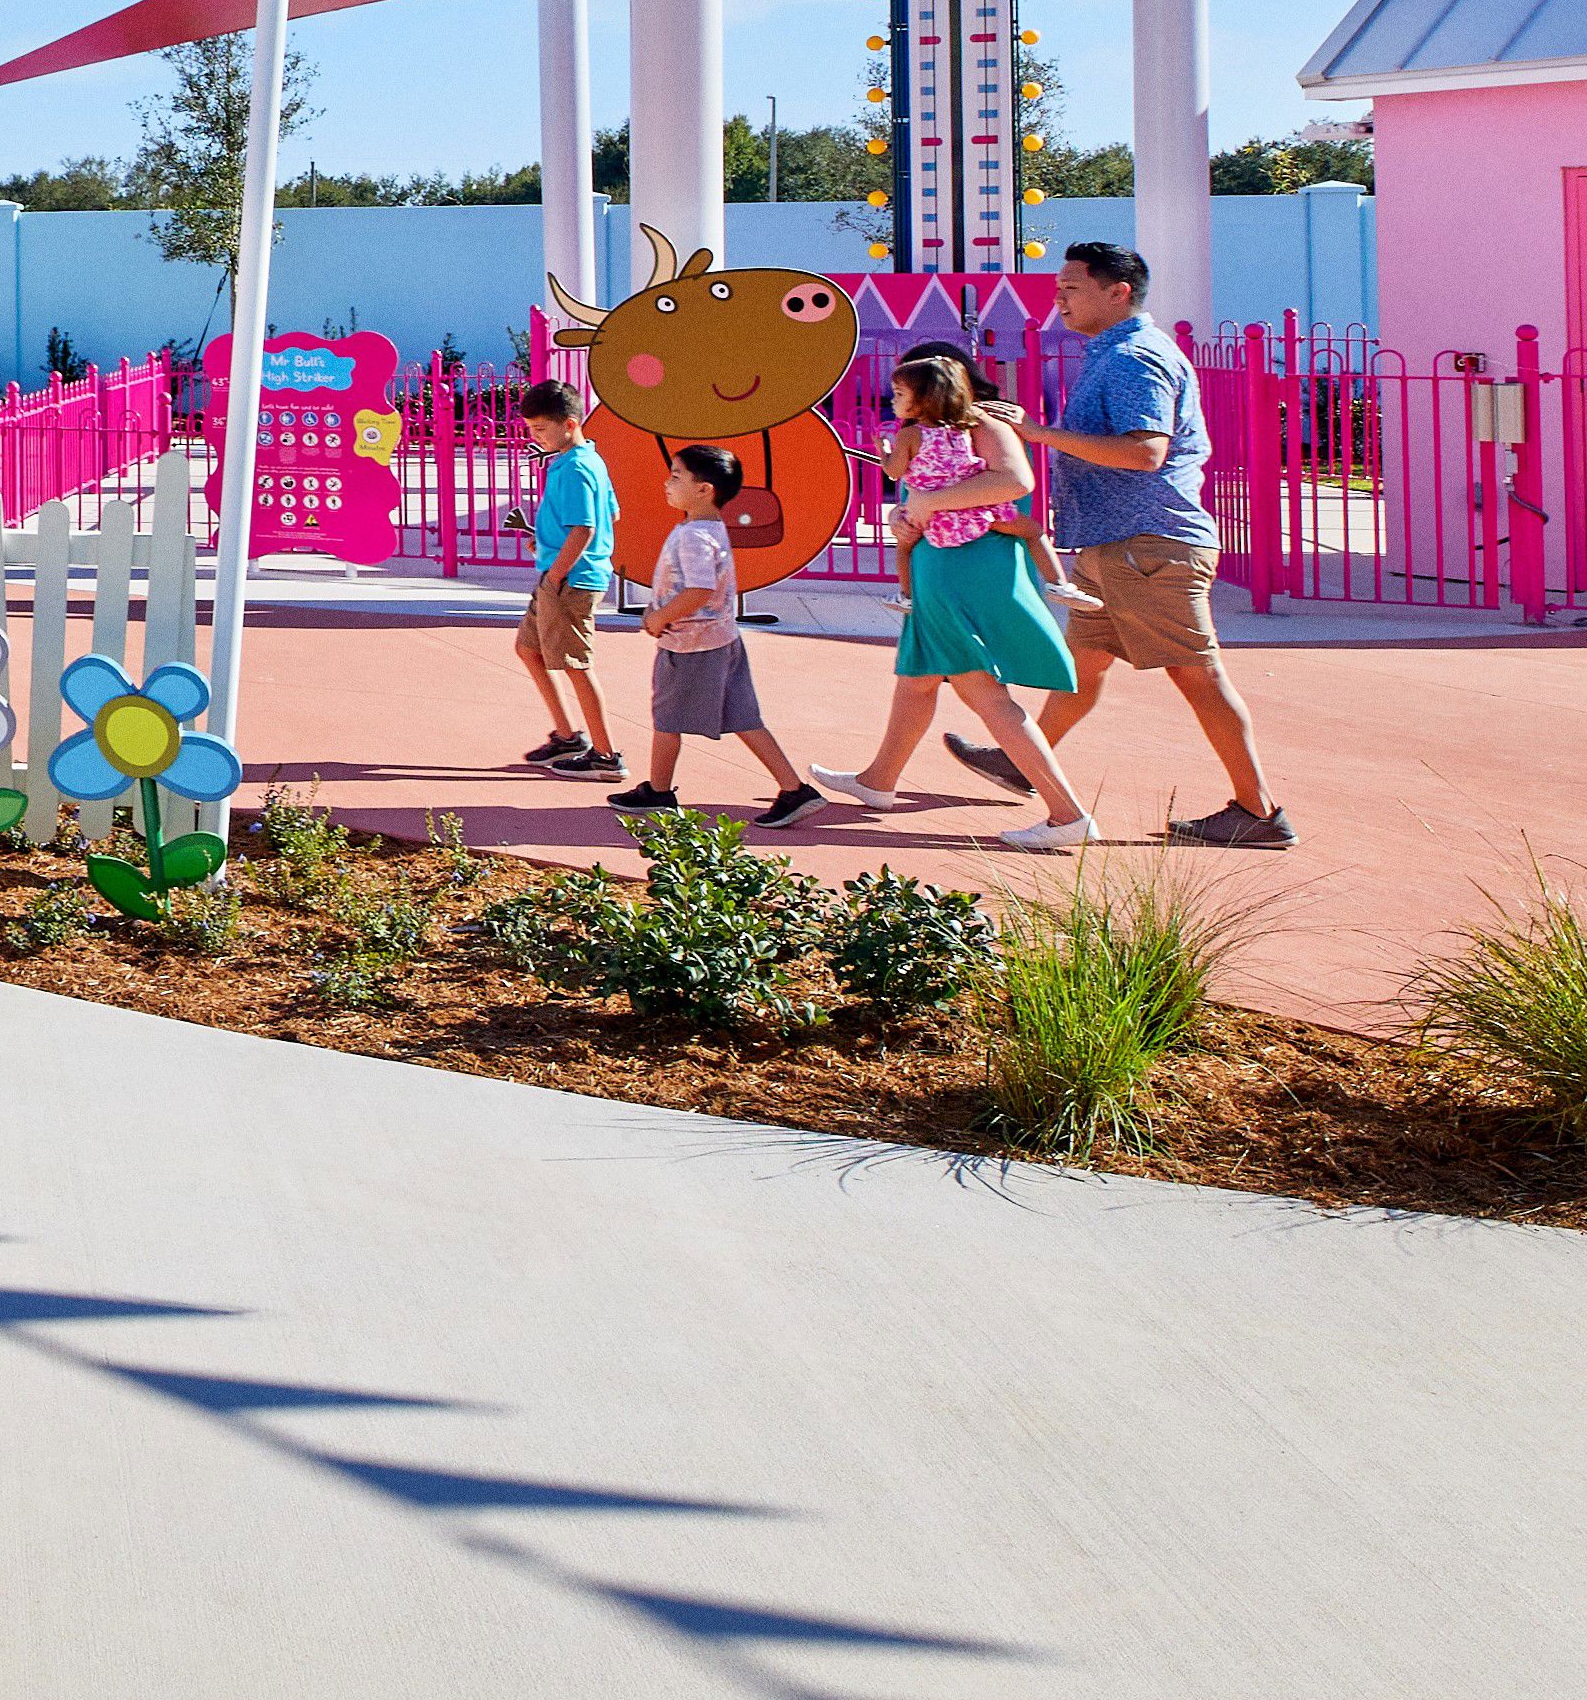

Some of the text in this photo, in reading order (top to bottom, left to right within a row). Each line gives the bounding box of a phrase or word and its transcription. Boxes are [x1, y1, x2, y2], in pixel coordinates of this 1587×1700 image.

[270, 355, 325, 368] Mr Bull's
[292, 371, 335, 383] Striker
